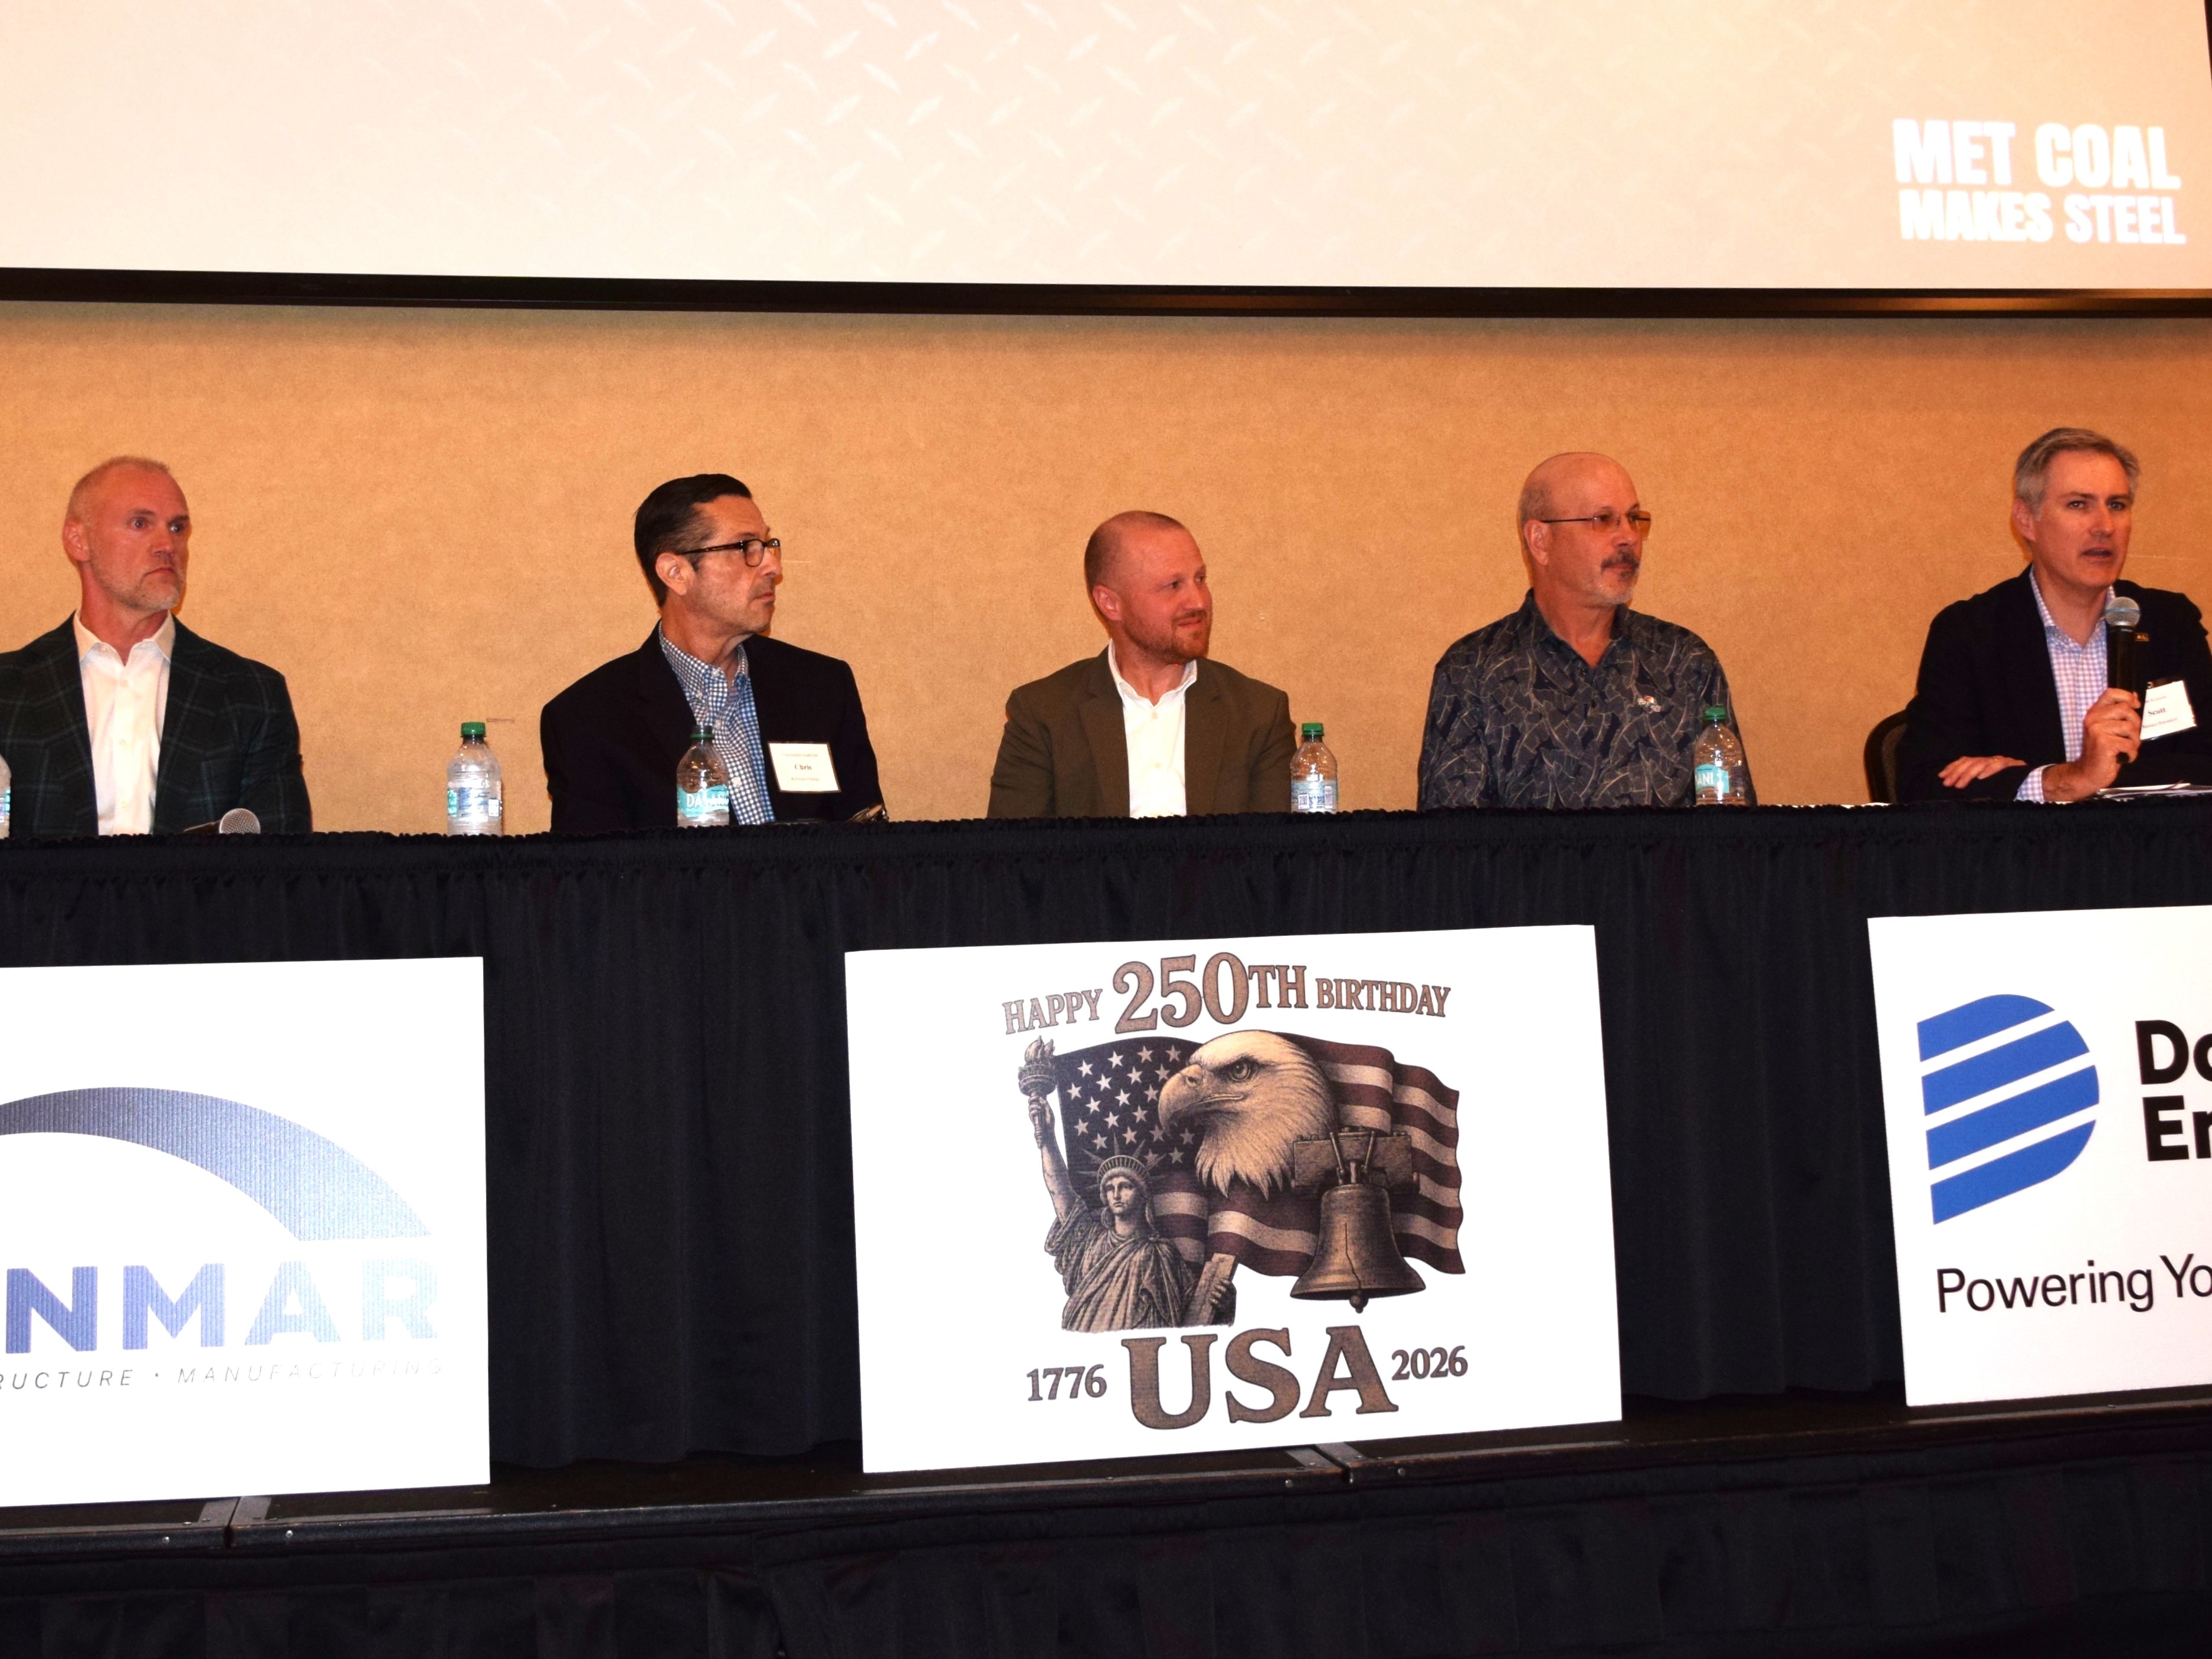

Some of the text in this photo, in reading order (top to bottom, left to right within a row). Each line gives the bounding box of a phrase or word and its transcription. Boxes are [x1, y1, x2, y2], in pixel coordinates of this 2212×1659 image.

[1893, 119, 2181, 189] MET COAL
[1898, 189, 2187, 244] MAKES STEEL
[2147, 707, 2167, 716] Scott
[1002, 952, 1451, 1035] HAPPY 250TH BIRTHDAY
[5, 1257, 438, 1354] NMAR
[1936, 1253, 2212, 1313] Powering Yo
[178, 1358, 443, 1383] MANUFACTURING
[1026, 1363, 1107, 1402] 1776
[1121, 1324, 1399, 1431] USA
[1391, 1345, 1469, 1381] 2026
